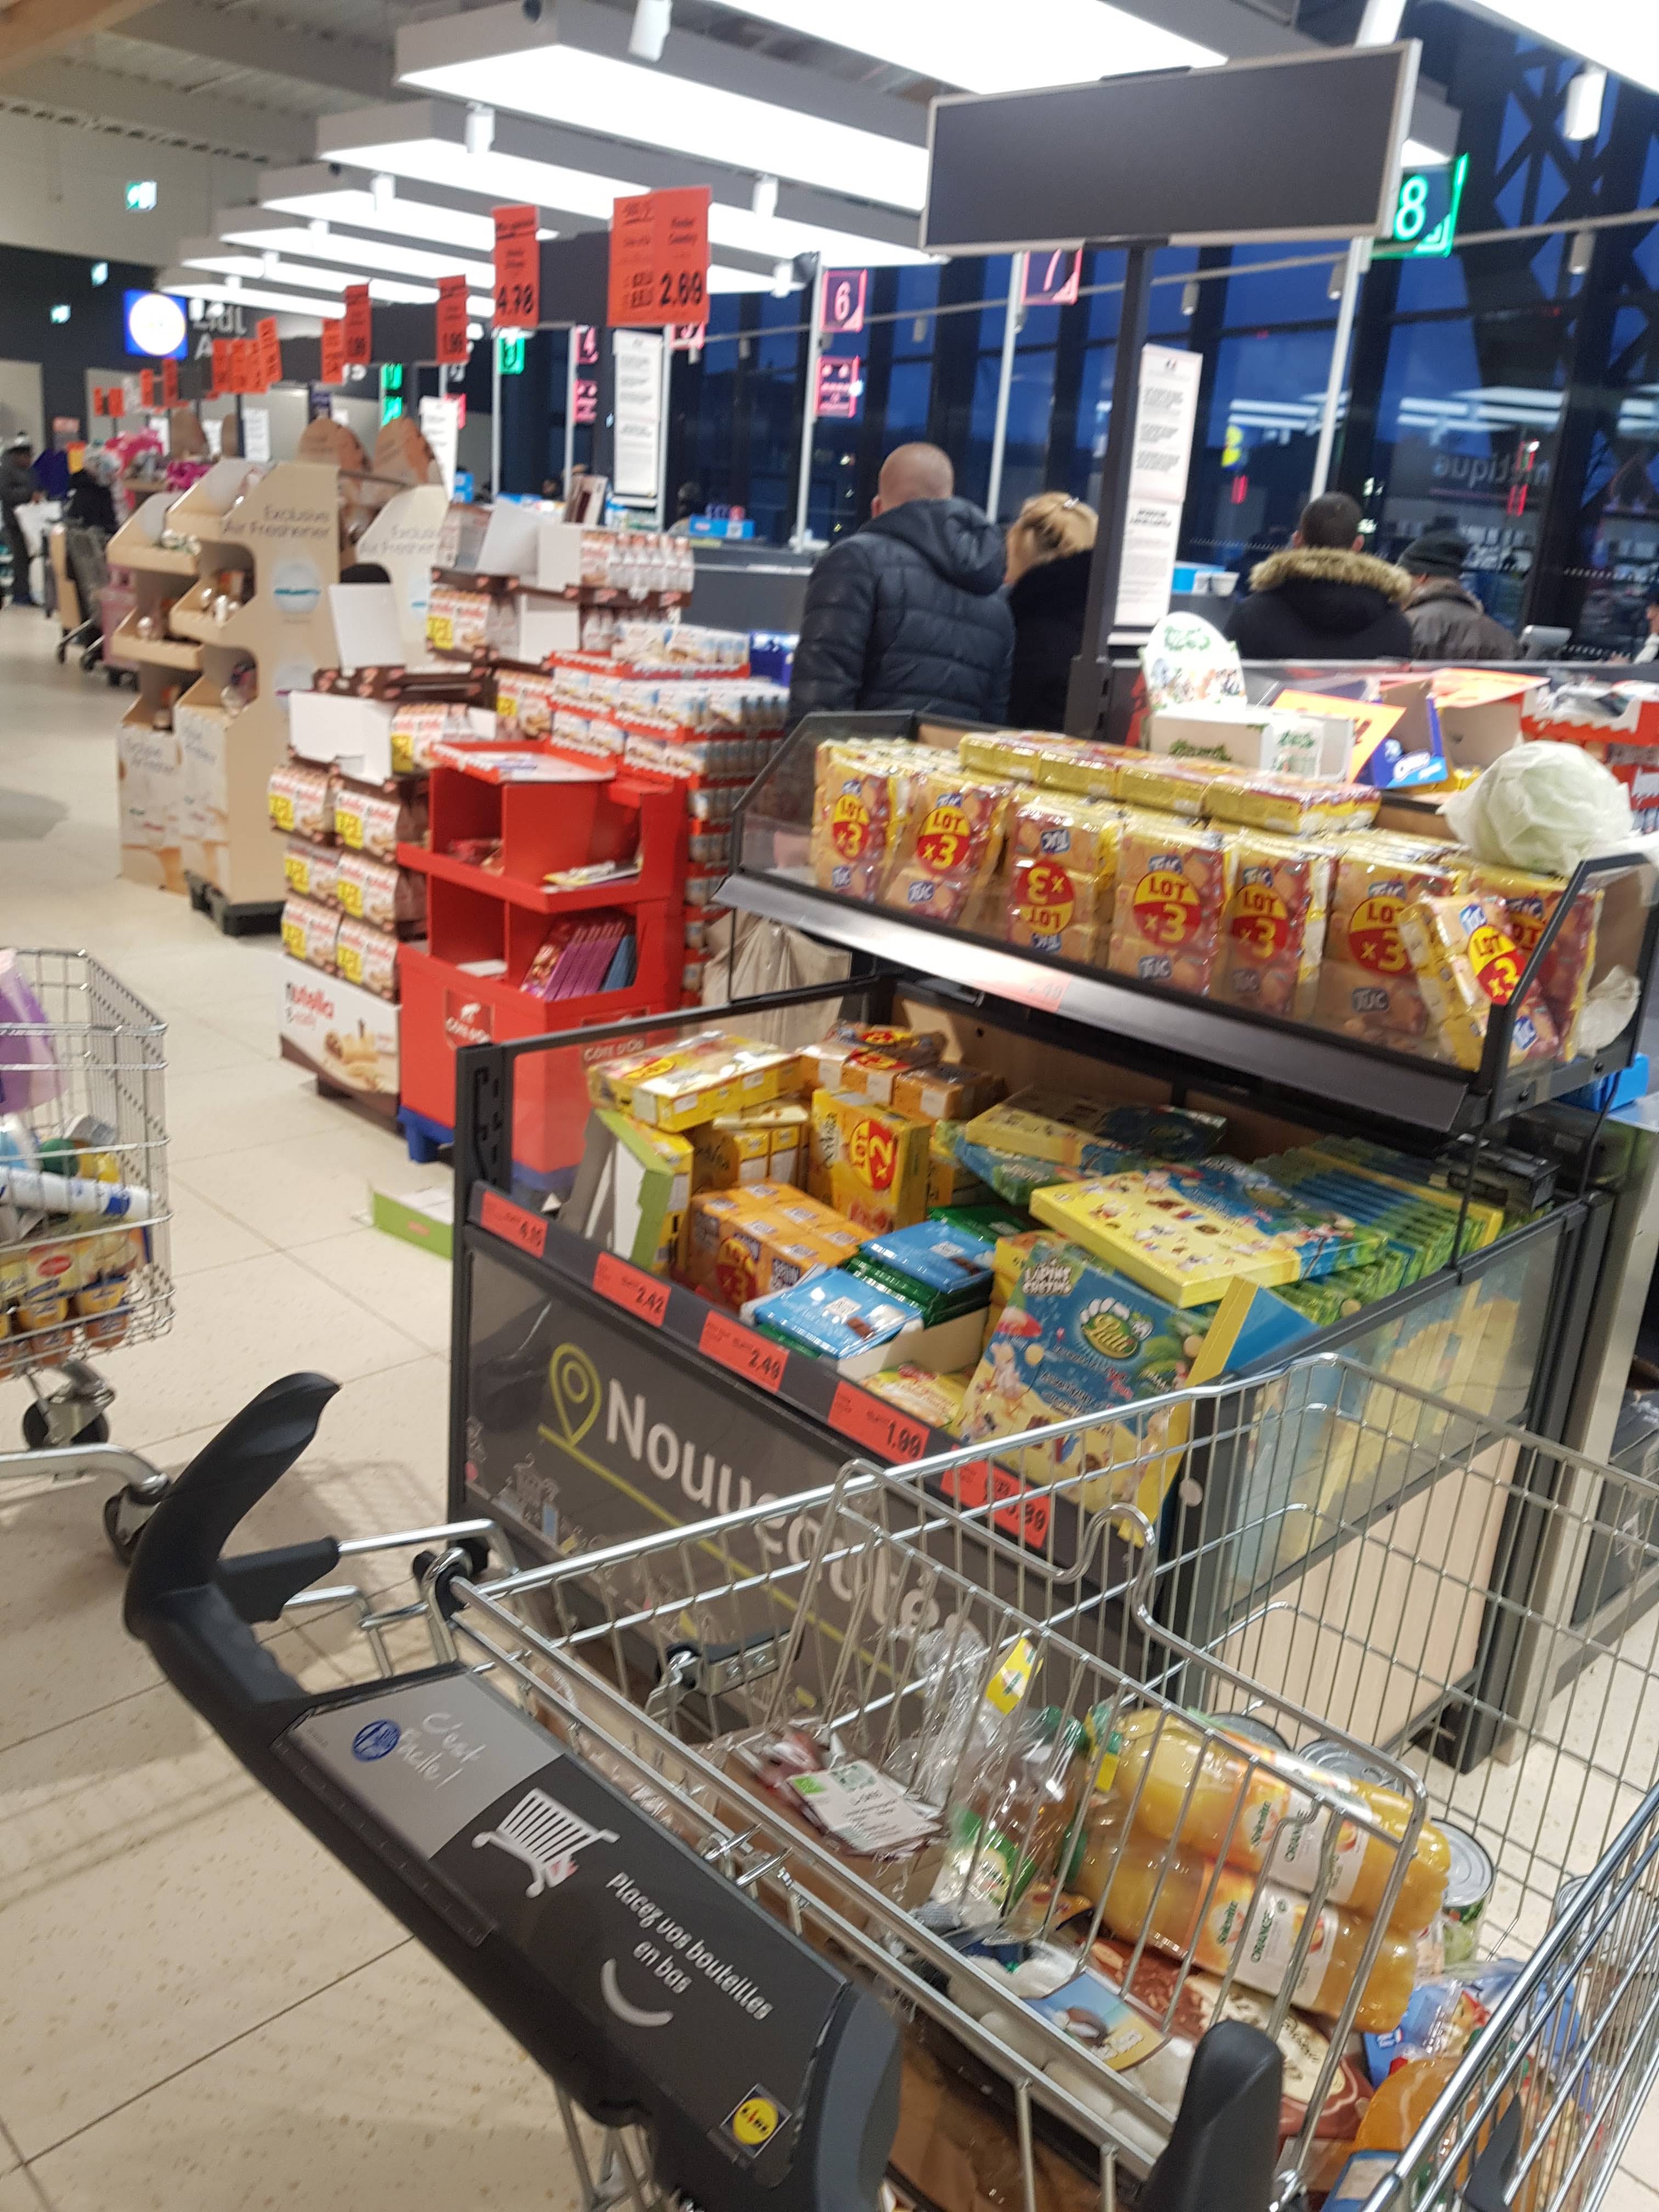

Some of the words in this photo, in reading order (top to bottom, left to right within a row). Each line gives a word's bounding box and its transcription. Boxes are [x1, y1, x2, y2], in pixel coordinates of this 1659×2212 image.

[1394, 175, 1429, 241] 8
[834, 281, 851, 321] 6
[841, 800, 863, 816] LOT
[933, 811, 965, 832] LOT
[1150, 877, 1189, 900] LOT
[1243, 891, 1277, 913] LOT
[1367, 901, 1404, 924] LO
[1474, 935, 1503, 957] LOT
[1353, 988, 1389, 1012] TUC
[605, 1871, 664, 1928] Placez
[656, 1917, 693, 1949] vos
[685, 1939, 774, 2020] bouteilles
[633, 1941, 661, 1967] en
[654, 1955, 693, 1994] bas
